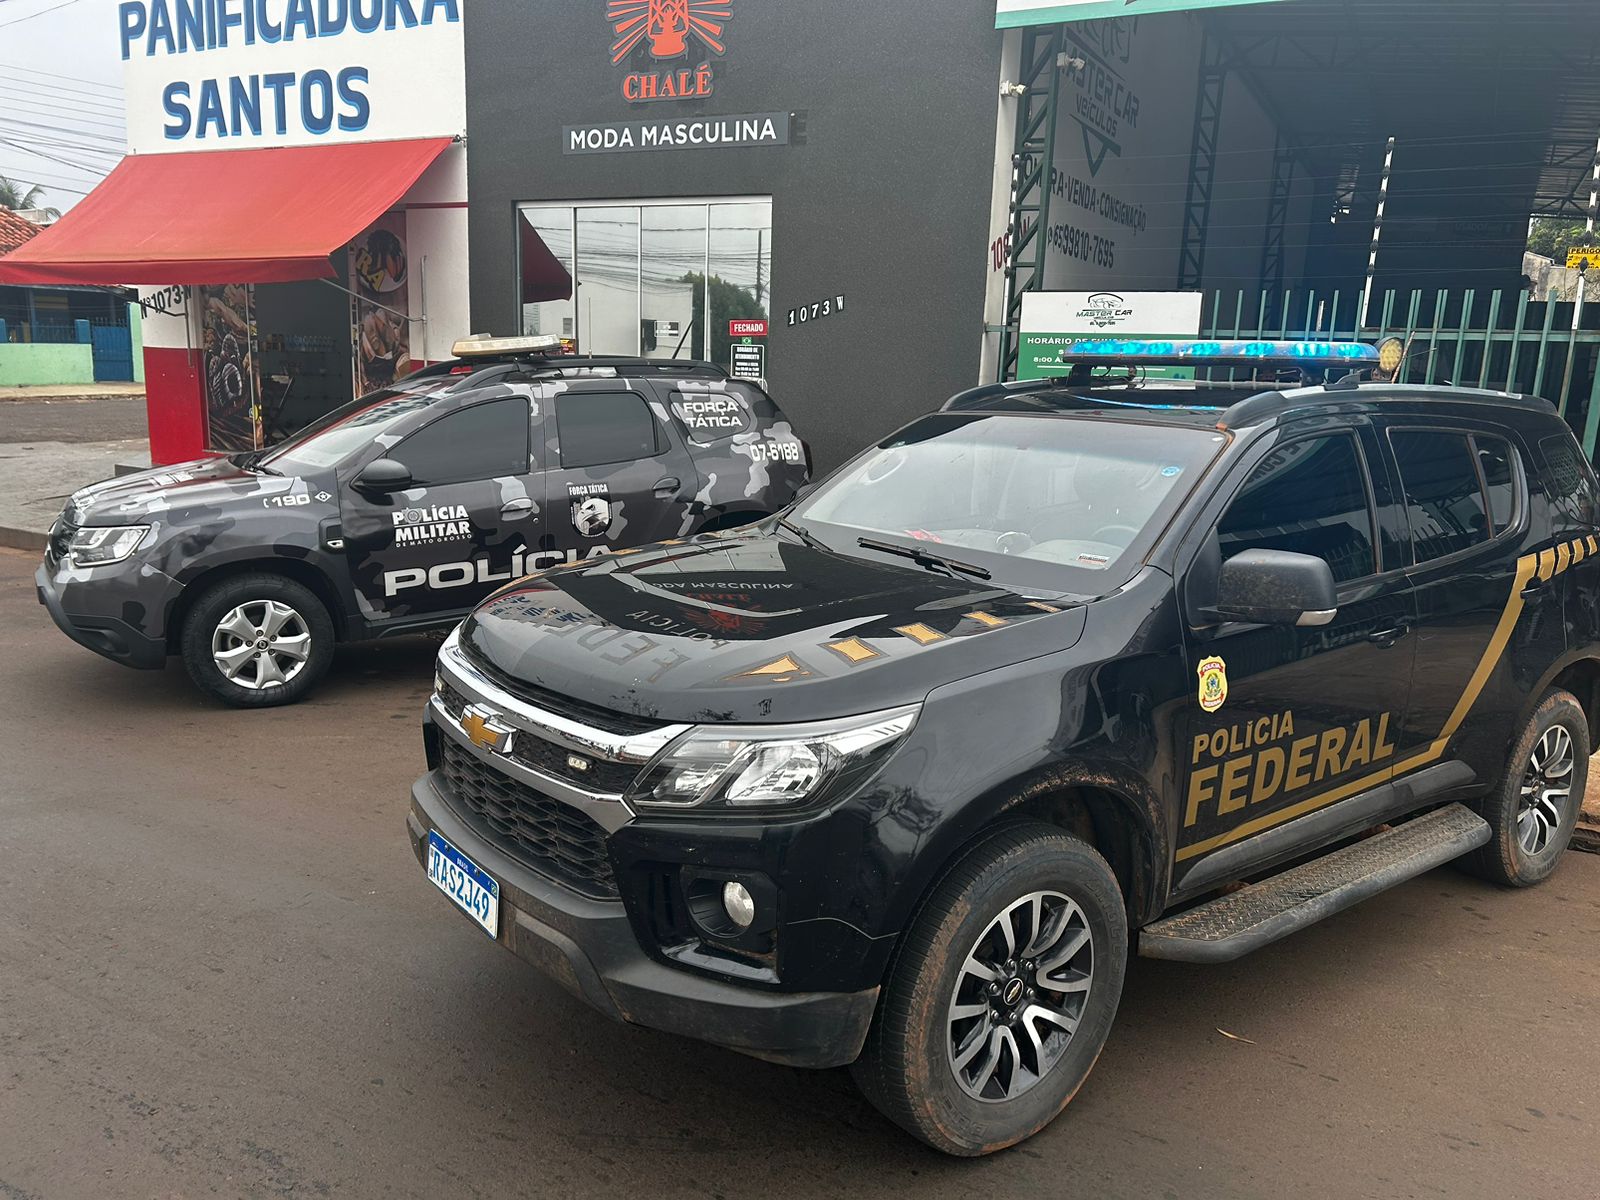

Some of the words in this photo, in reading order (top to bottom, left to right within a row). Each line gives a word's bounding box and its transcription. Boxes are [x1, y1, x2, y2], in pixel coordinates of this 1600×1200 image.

[623, 64, 713, 100] CHALÉ
[162, 66, 370, 140] SANTOS
[570, 130, 634, 150] MODA
[641, 118, 777, 146] MASCULINA
[733, 322, 764, 333] FECHADO
[1027, 337, 1072, 345] HORÁRIO
[683, 401, 739, 415] FORÇA
[685, 414, 743, 428] TÁTICA
[750, 442, 799, 461] 07-6188
[568, 485, 588, 496] FORÇA
[588, 483, 609, 494] TÁTICA
[271, 493, 311, 507] 190
[396, 521, 471, 542] MILITAR
[437, 533, 473, 543] GROSSO
[384, 543, 614, 597] POLÍCIA
[1192, 710, 1295, 764] POLÍCIA
[1184, 711, 1394, 828] FEDERAL
[433, 851, 489, 922] RAS2J49
